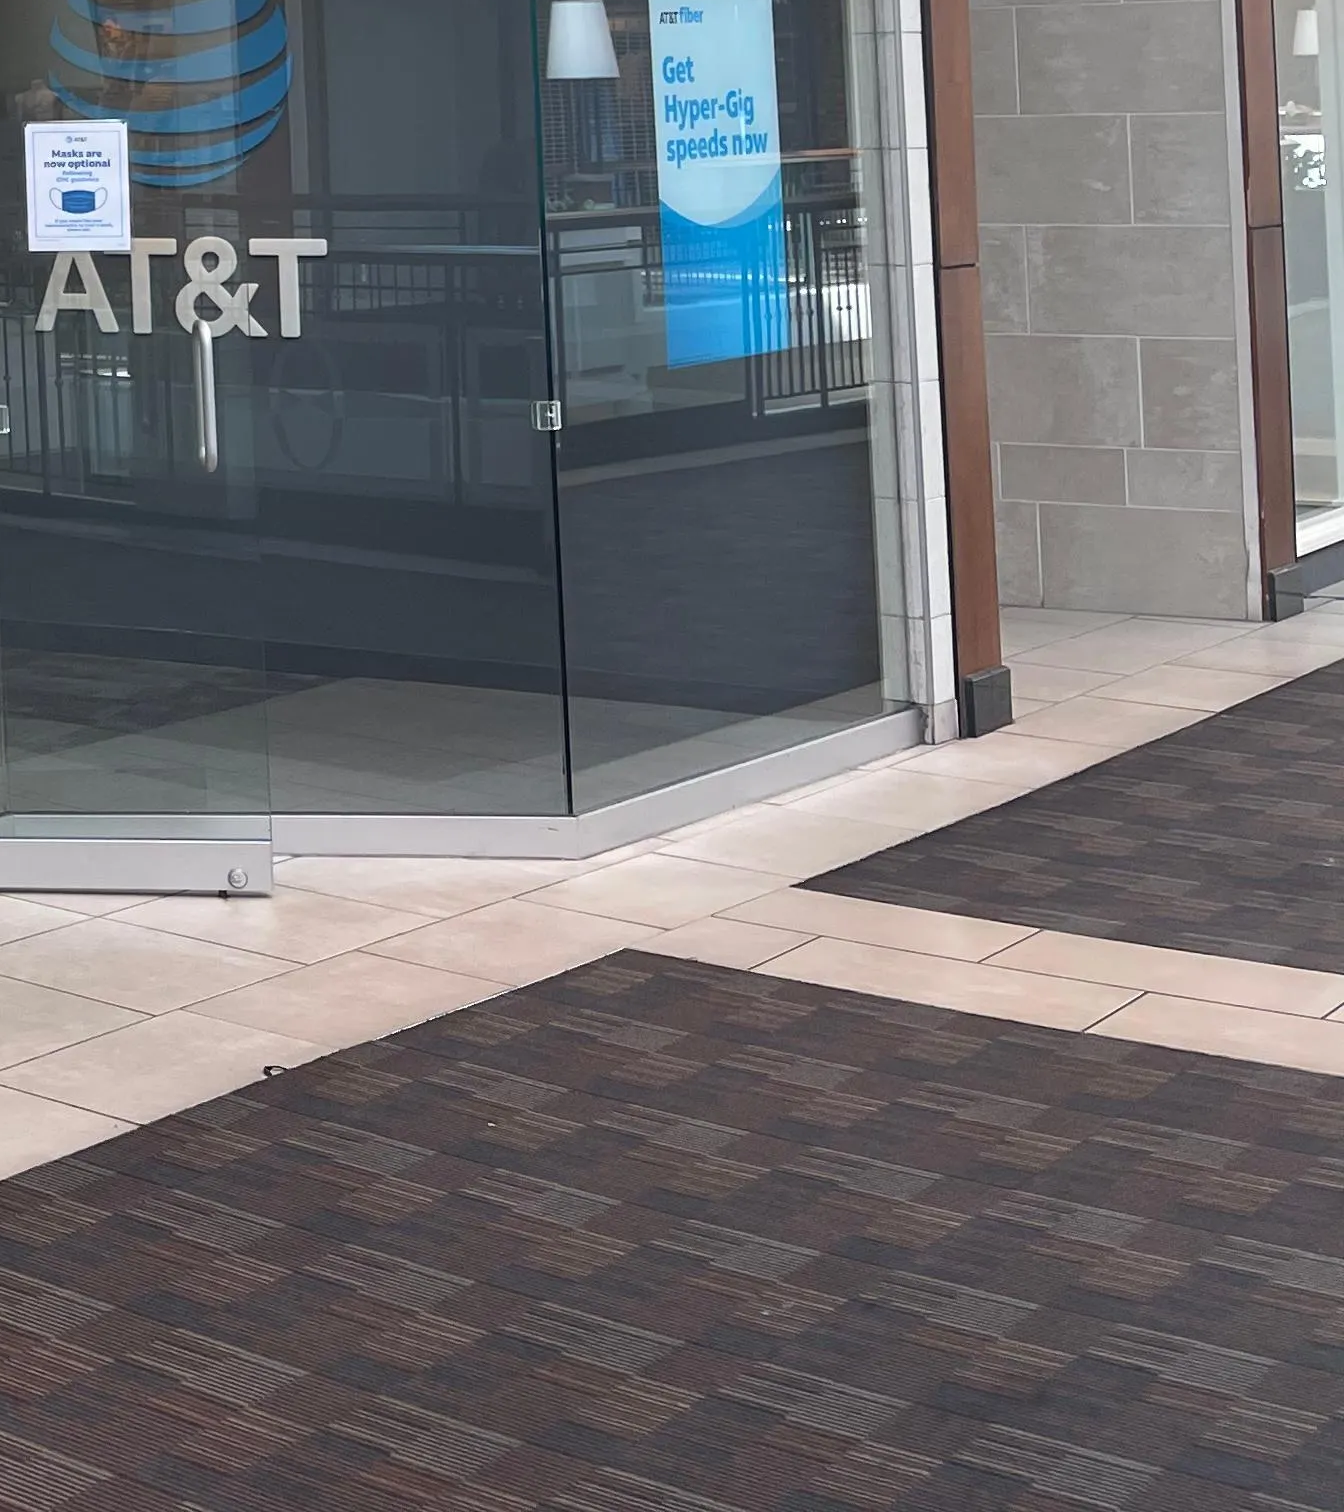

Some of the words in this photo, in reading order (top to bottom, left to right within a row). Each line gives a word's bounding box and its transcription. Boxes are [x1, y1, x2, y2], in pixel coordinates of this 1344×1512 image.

[659, 10, 679, 25] AT&T
[679, 6, 704, 24] fiber
[662, 55, 696, 84] Get
[663, 88, 755, 130] Hyper-Gig
[51, 149, 84, 158] Masks
[665, 127, 729, 169] speeds
[732, 130, 769, 156] now
[43, 160, 66, 168] now
[67, 159, 111, 169] optional
[34, 236, 328, 339] AT&T
